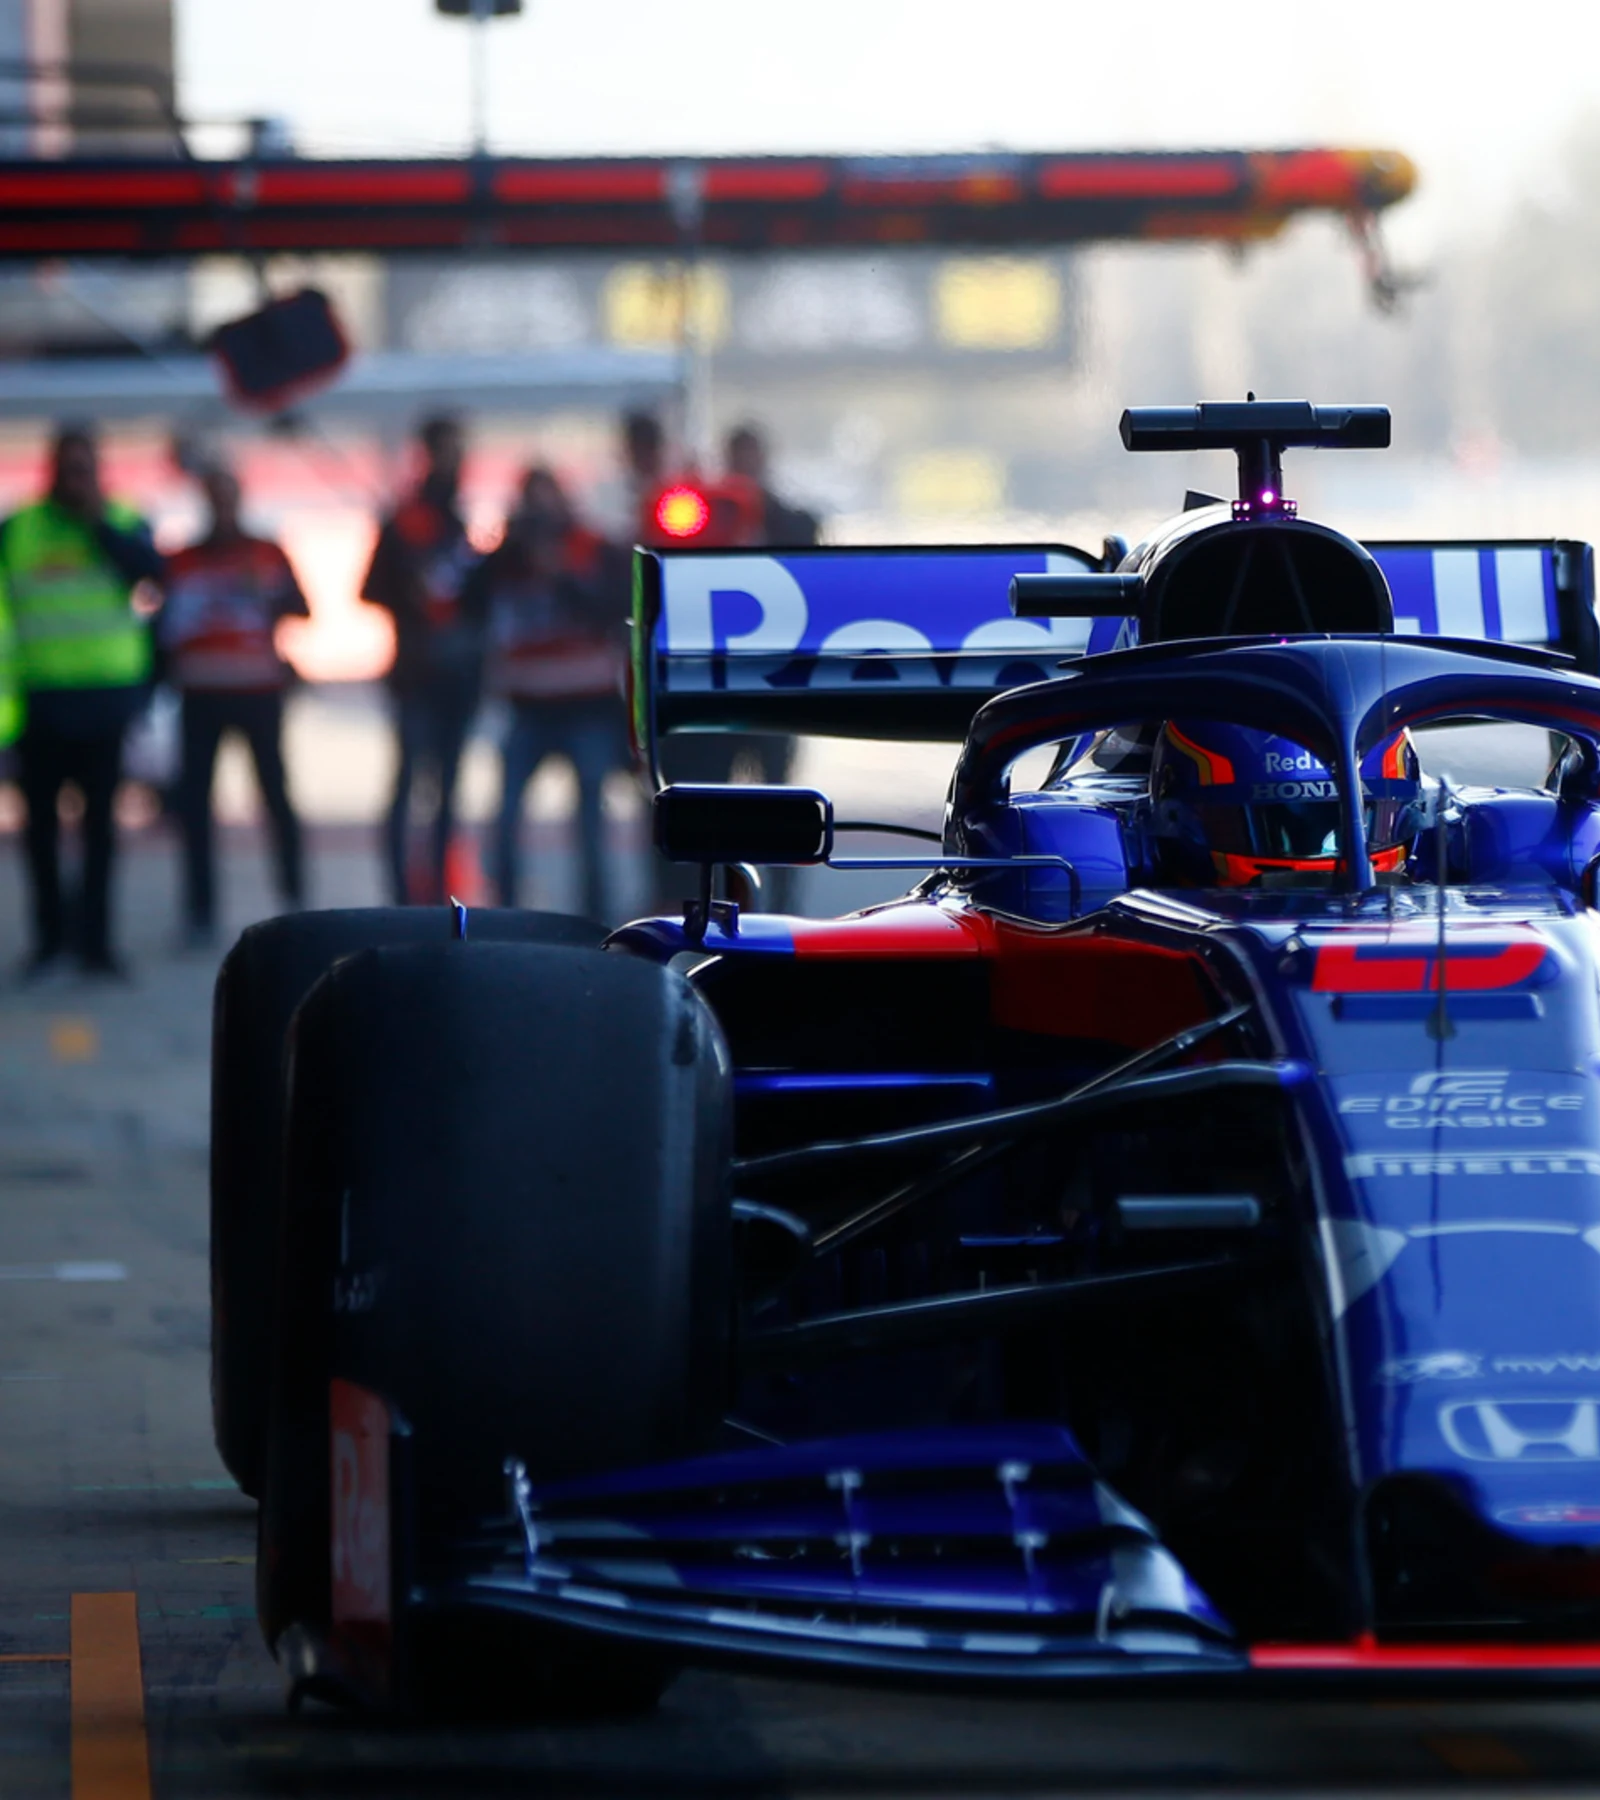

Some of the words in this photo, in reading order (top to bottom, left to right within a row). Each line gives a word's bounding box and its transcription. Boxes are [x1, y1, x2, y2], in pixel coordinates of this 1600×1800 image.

[1265, 751, 1311, 774] Red
[1339, 1096, 1584, 1113] EDIFICE
[1385, 1115, 1548, 1129] CASIO
